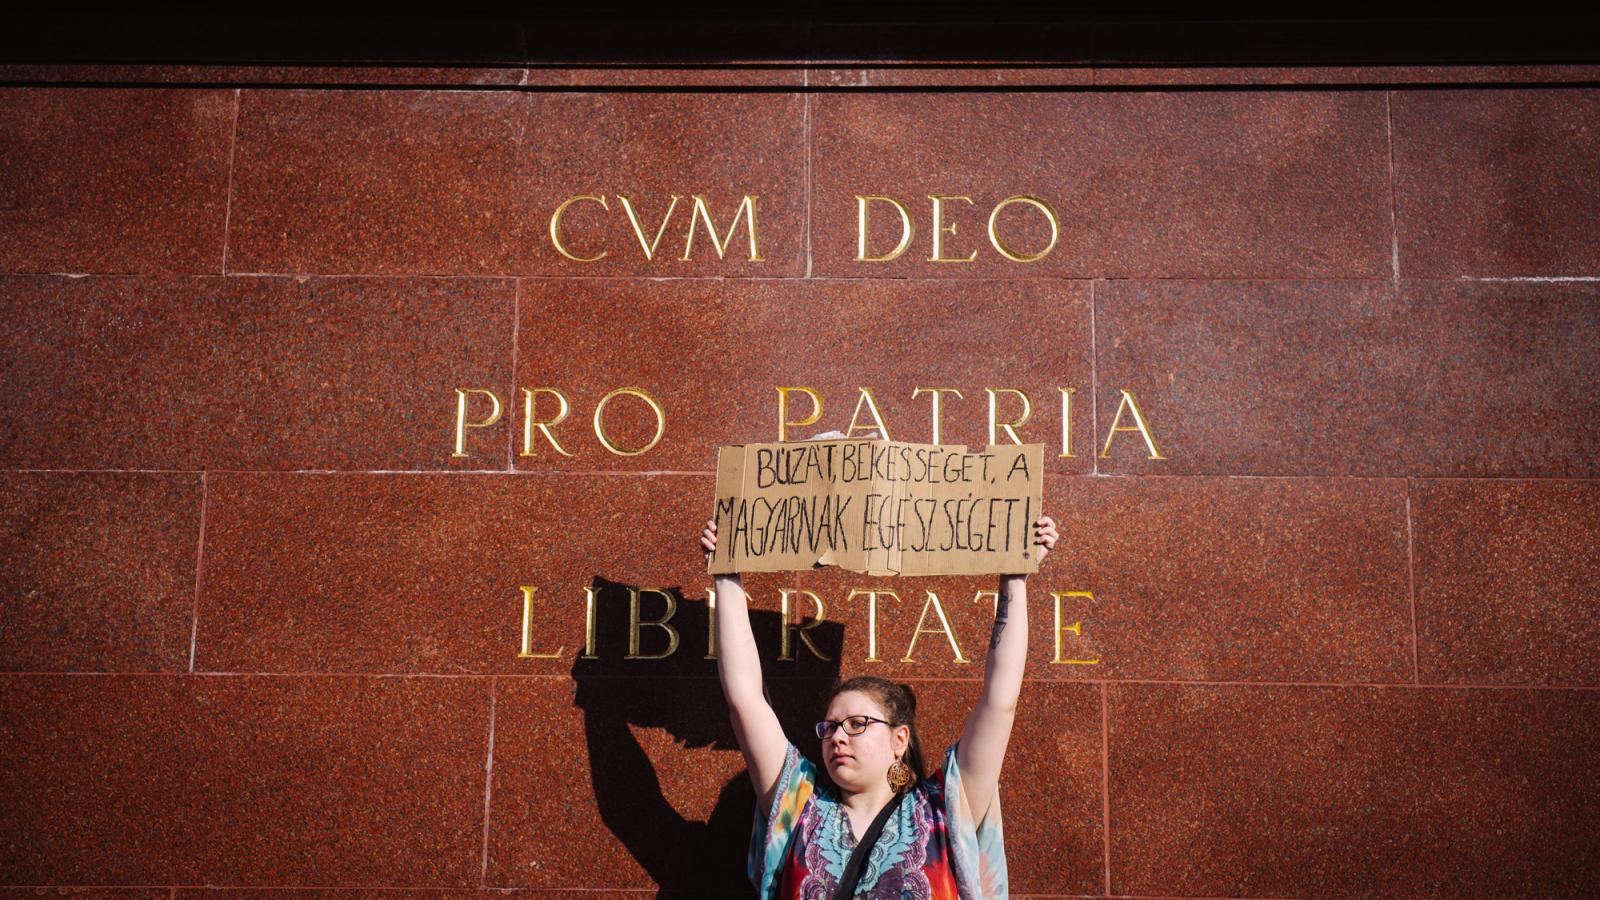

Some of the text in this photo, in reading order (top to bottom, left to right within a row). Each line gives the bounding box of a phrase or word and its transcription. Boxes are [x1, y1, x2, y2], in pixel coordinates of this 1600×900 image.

[549, 193, 1062, 264] CVM DEO
[452, 386, 1167, 461] PRO PATRIA
[1006, 452, 1030, 482] A
[712, 494, 852, 563] MAGYARNAK
